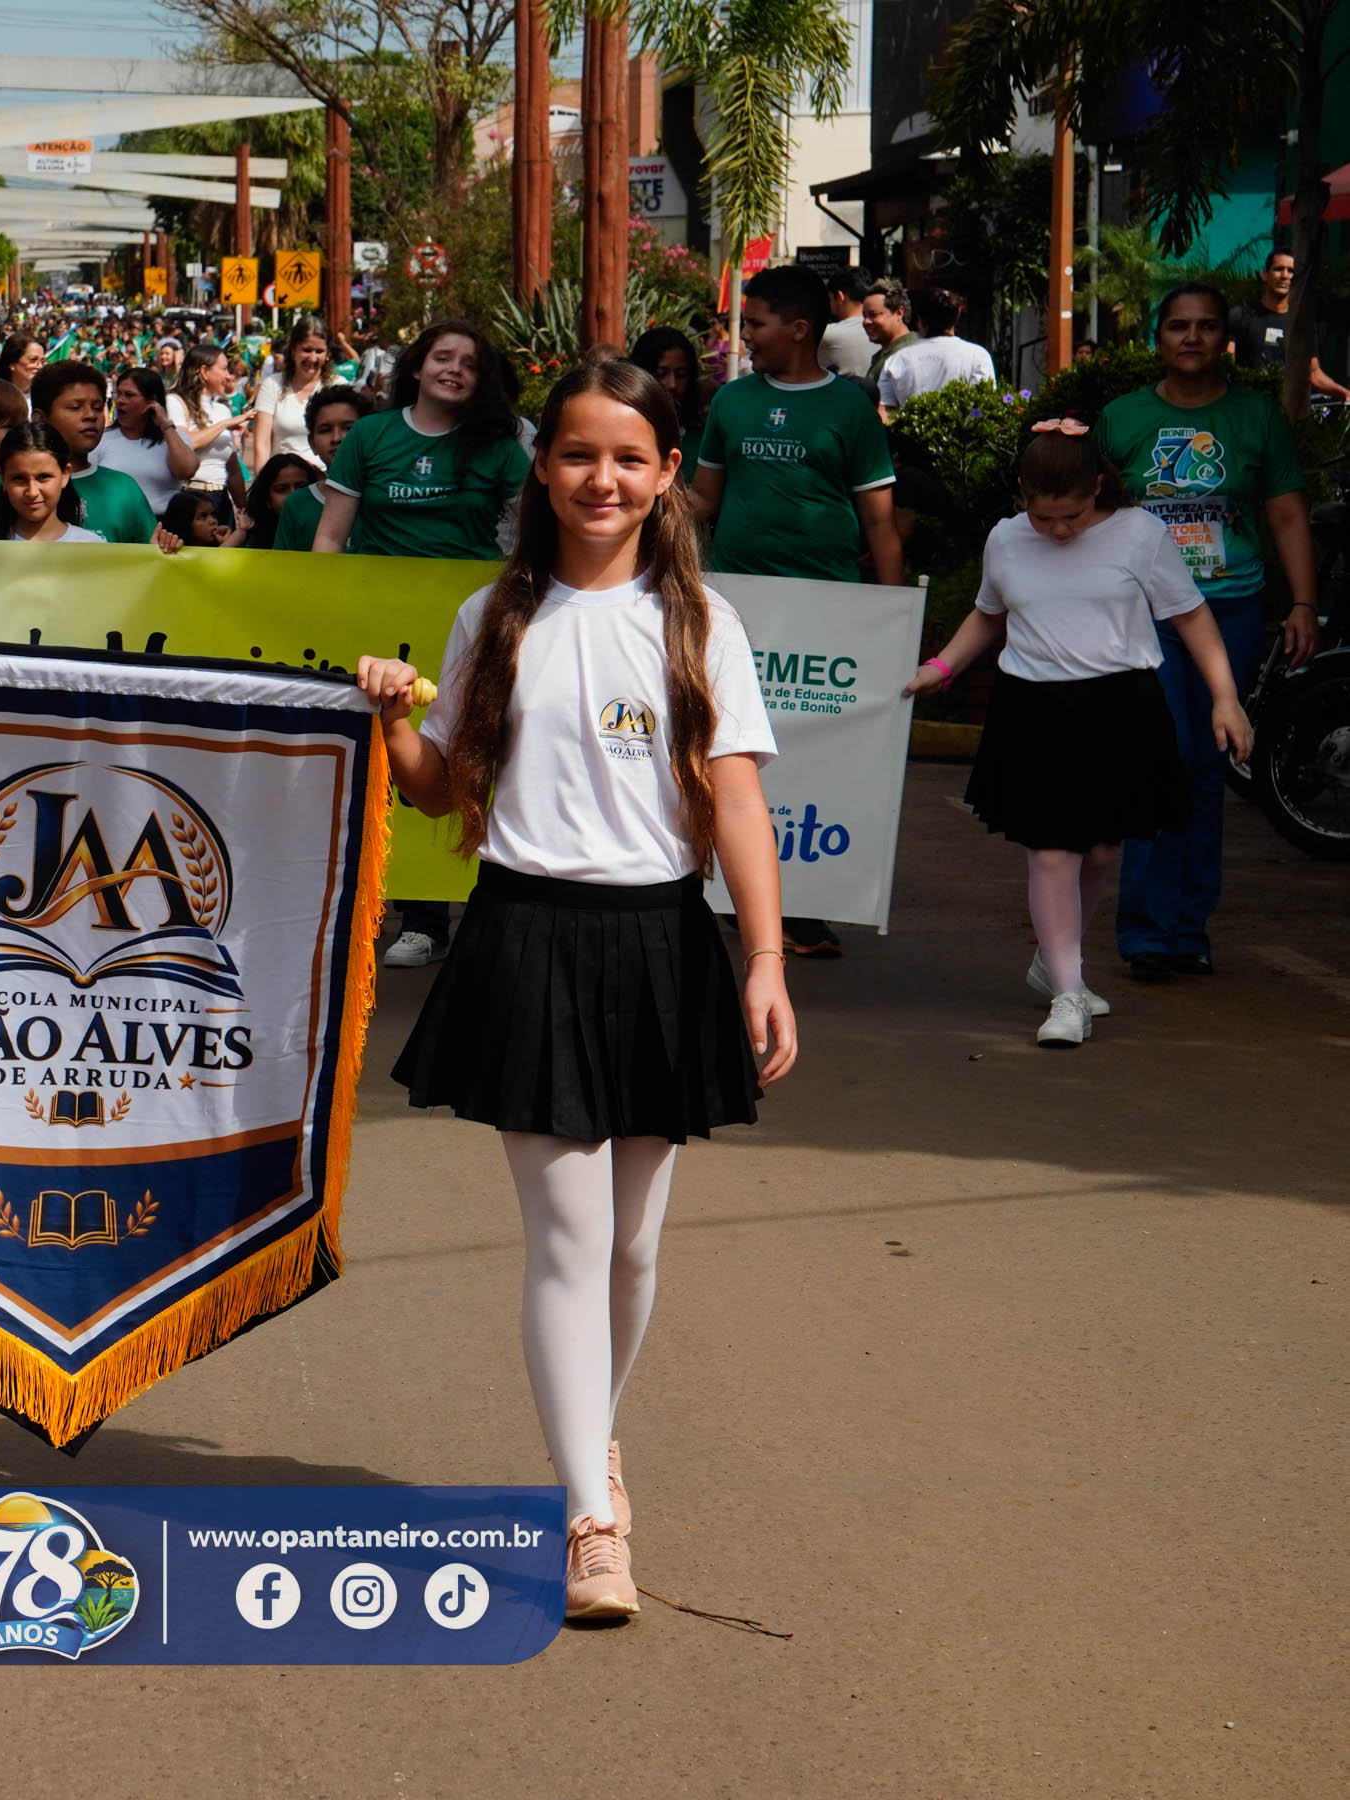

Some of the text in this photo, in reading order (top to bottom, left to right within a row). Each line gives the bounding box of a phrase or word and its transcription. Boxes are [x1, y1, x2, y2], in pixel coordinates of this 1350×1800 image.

[34, 140, 86, 152] ATENÇÃO
[1160, 429, 1195, 438] BONITO
[742, 442, 807, 459] BONITO
[775, 687, 791, 698] de
[794, 688, 857, 703] Educação
[781, 700, 797, 710] de
[800, 701, 842, 714] Bonito
[624, 747, 653, 757] ALVES
[777, 805, 792, 816] de
[70, 994, 201, 1014] MUNICIPAL
[70, 1011, 254, 1070] ALVES
[39, 1068, 172, 1090] ARRUDA
